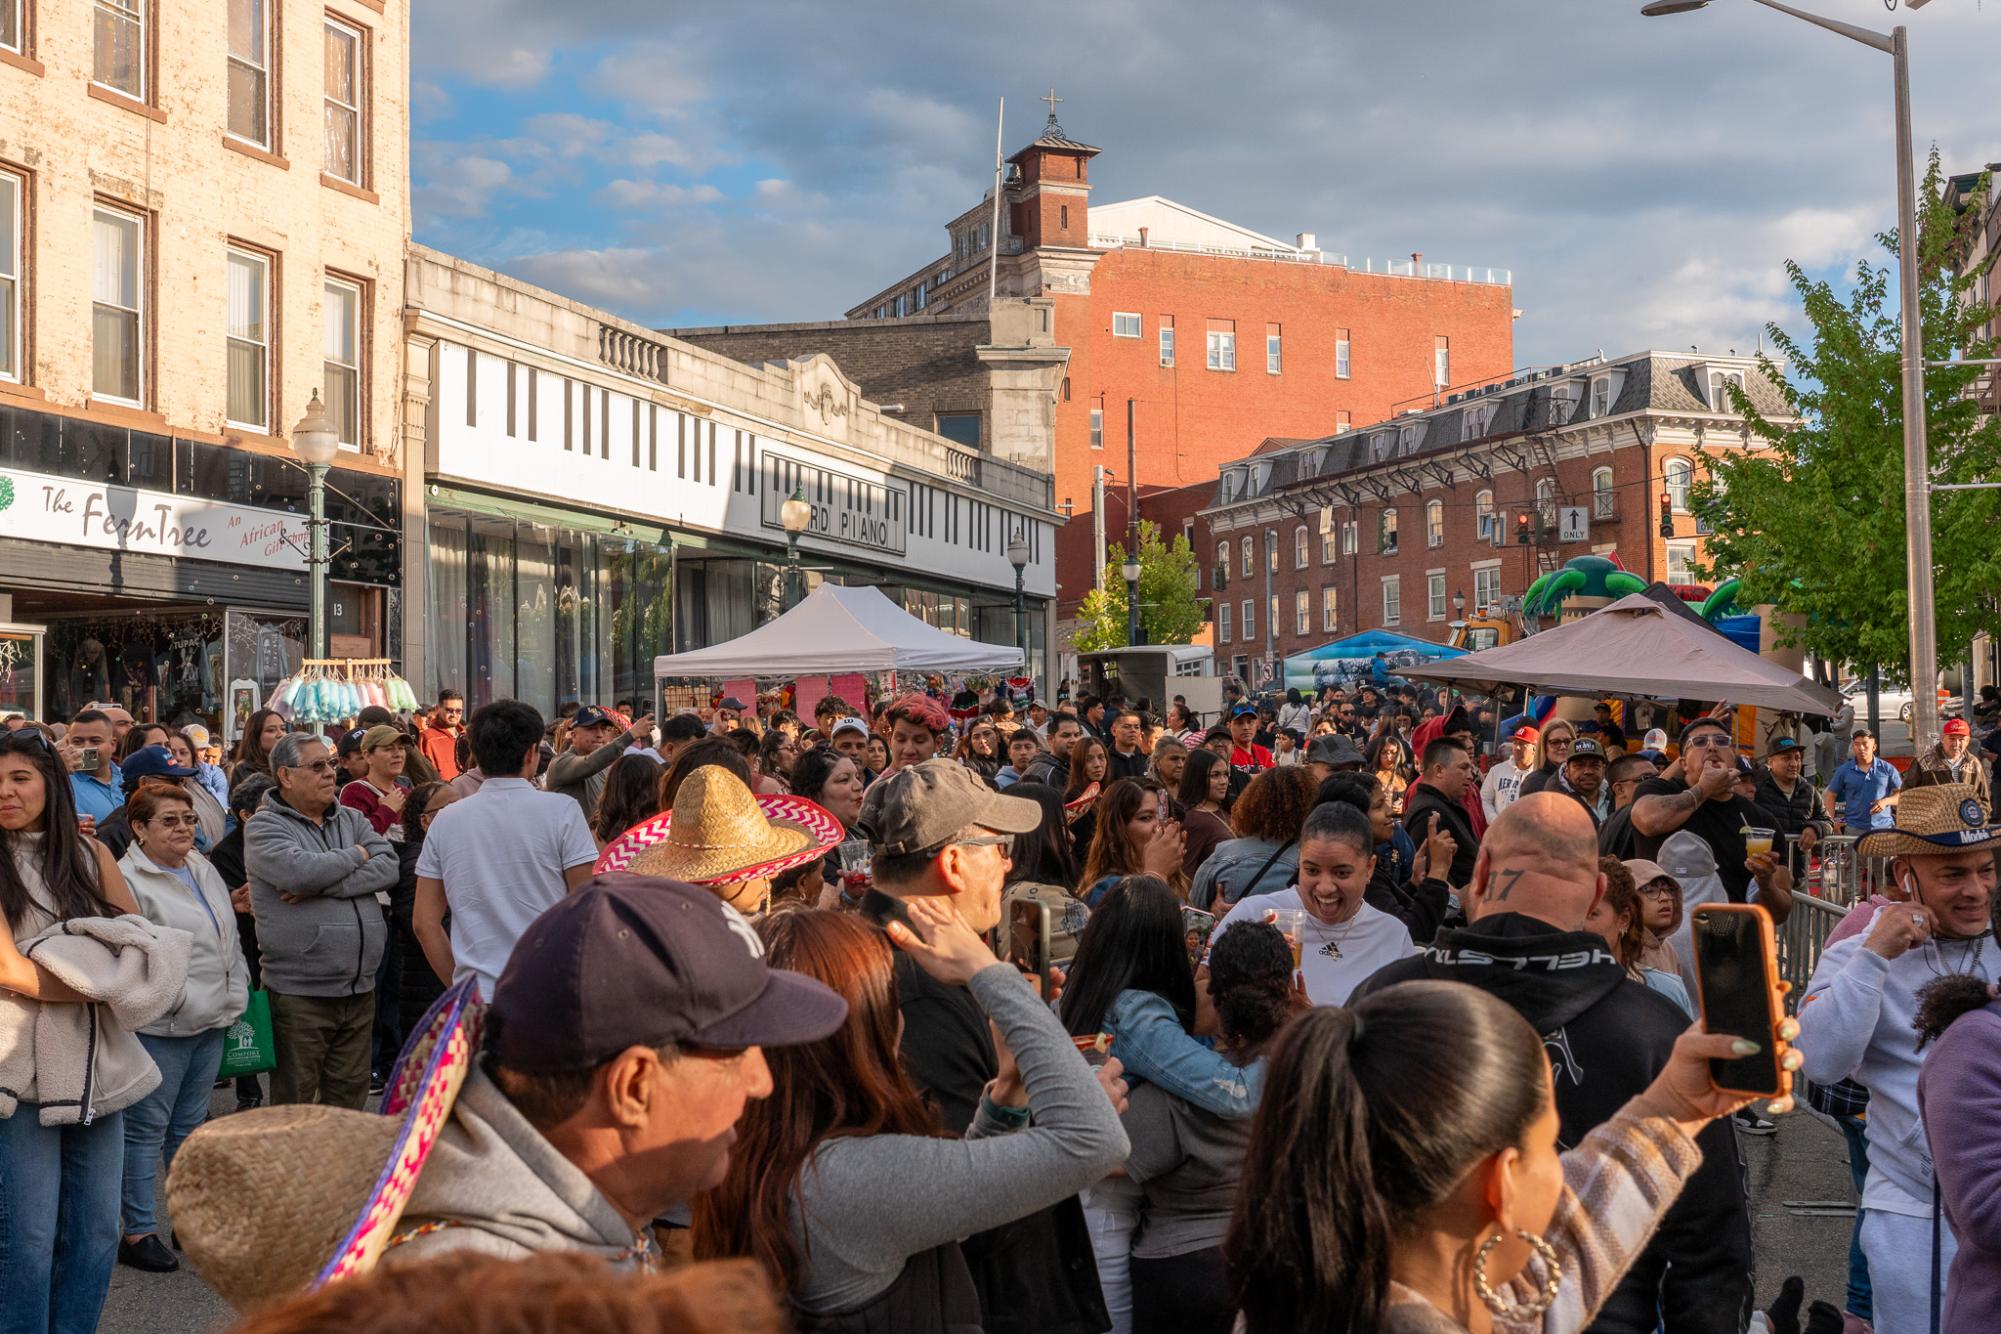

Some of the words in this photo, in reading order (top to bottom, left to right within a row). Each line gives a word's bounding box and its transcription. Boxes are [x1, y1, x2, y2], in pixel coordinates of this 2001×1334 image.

[42, 486, 75, 513] The
[228, 516, 241, 529] An
[841, 512, 886, 545] PIANO
[240, 520, 283, 548] African
[1563, 531, 1585, 539] ONLY
[264, 541, 284, 557] Gift
[333, 603, 343, 617] 13
